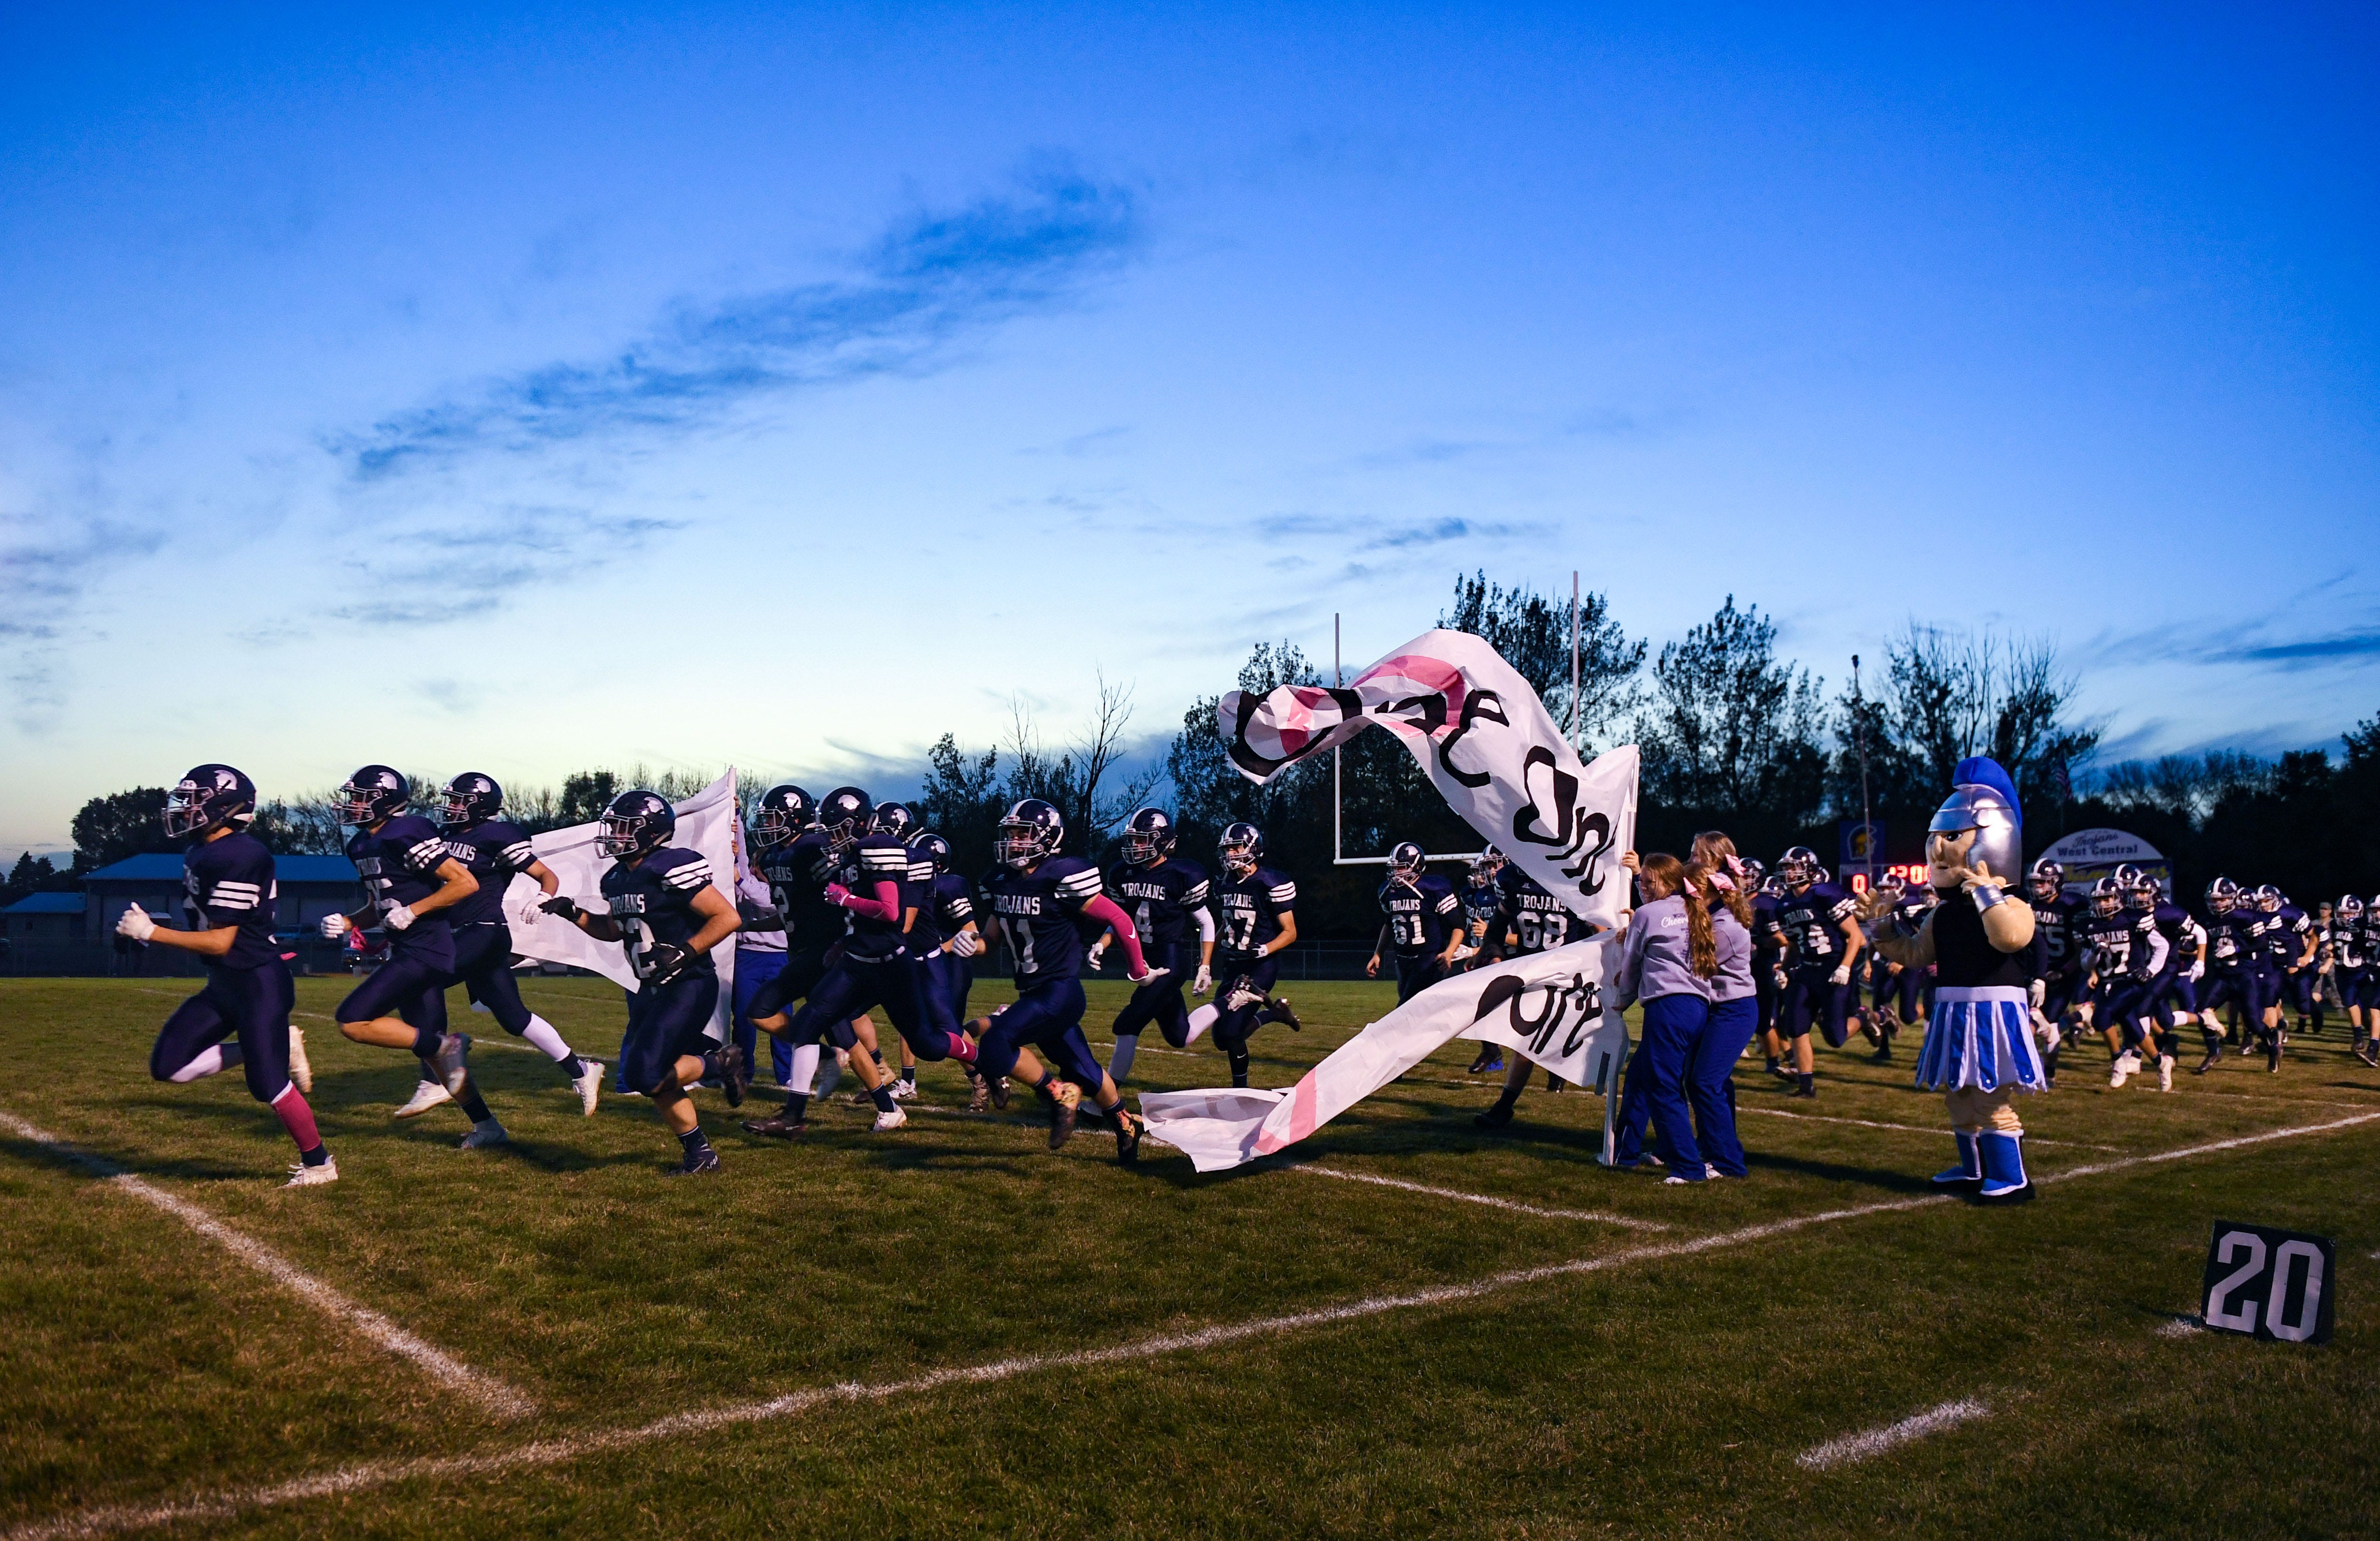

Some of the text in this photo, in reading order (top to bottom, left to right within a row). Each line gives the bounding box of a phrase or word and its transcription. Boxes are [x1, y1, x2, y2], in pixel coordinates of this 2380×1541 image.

[994, 894, 1041, 915] TROJANS
[1122, 882, 1166, 901] TROJANS
[1135, 901, 1153, 944] 4
[1392, 914, 1426, 945] 61
[1517, 910, 1568, 950] 68
[999, 918, 1039, 973] 11
[2206, 1230, 2324, 1342] 20
